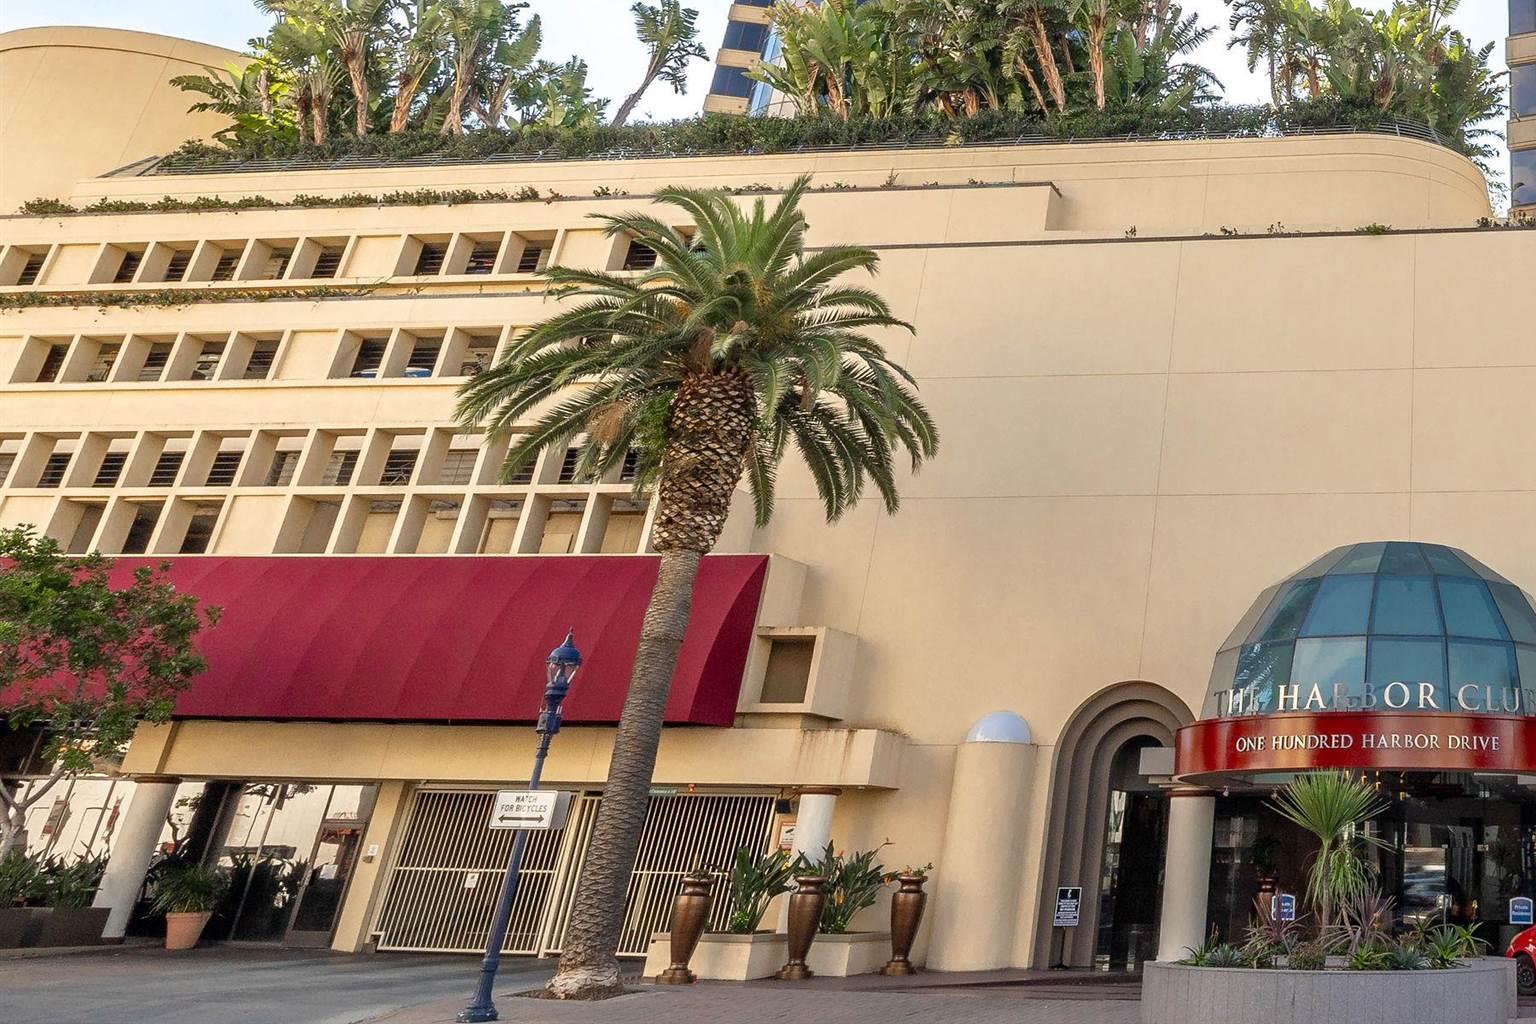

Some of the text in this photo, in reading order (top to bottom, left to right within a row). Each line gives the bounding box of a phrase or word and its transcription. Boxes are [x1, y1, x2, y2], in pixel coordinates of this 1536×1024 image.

[1277, 681, 1440, 711] HARBOR
[1457, 683, 1536, 714] CLUB
[1235, 733, 1500, 753] ONE HUNDRED HARBOR DRIVE
[515, 795, 538, 803] WATCH
[500, 804, 548, 813] FOR BICYCLES
